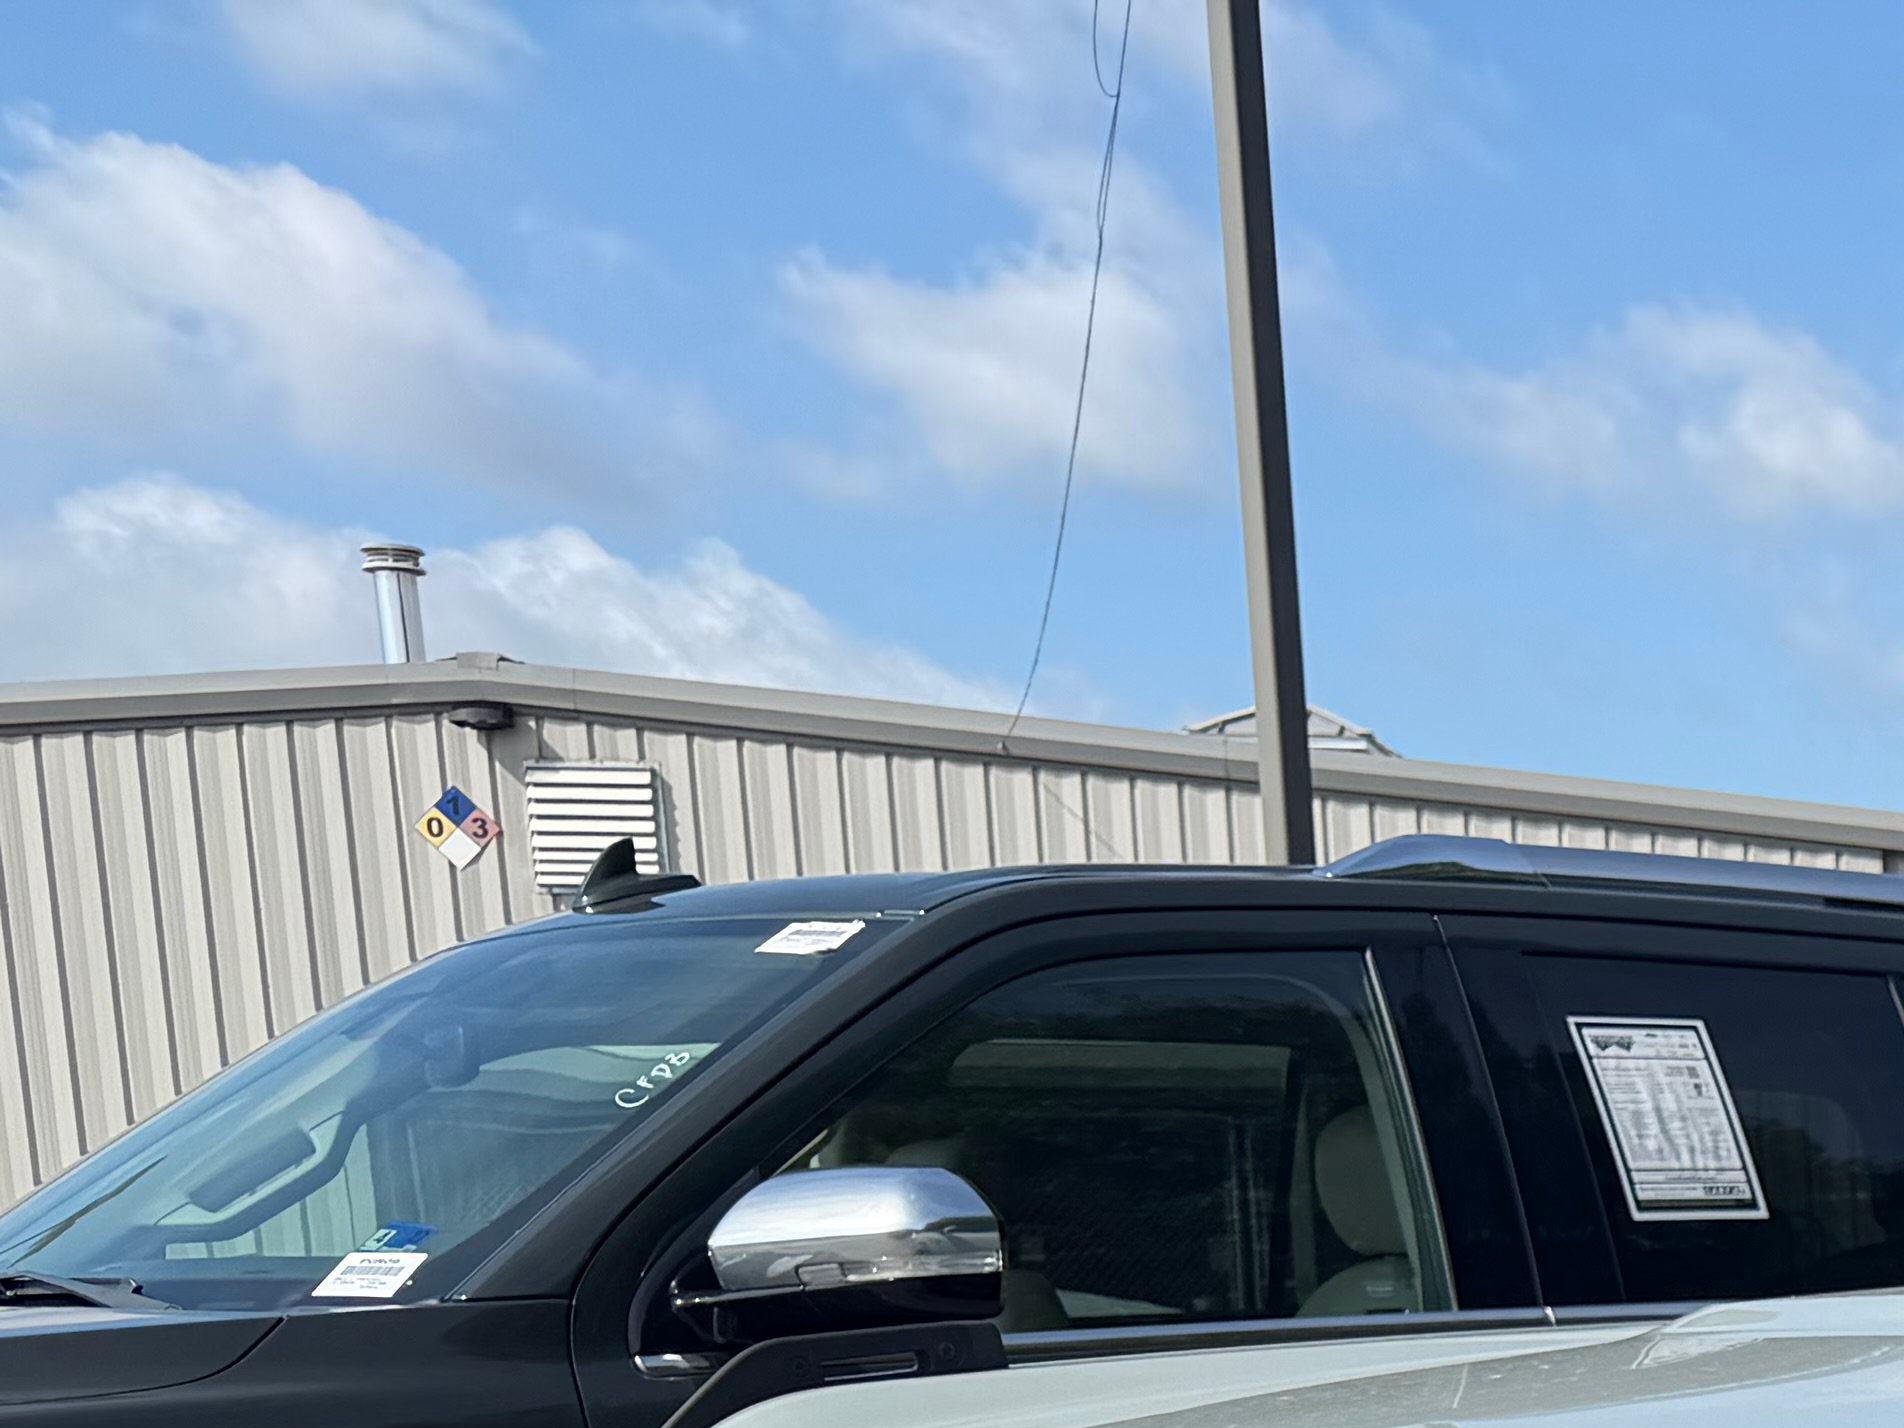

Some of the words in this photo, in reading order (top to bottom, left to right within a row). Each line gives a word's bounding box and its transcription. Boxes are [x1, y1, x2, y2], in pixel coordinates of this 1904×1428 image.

[446, 796, 460, 816] 1
[426, 817, 444, 838] 0
[471, 817, 489, 839] 3
